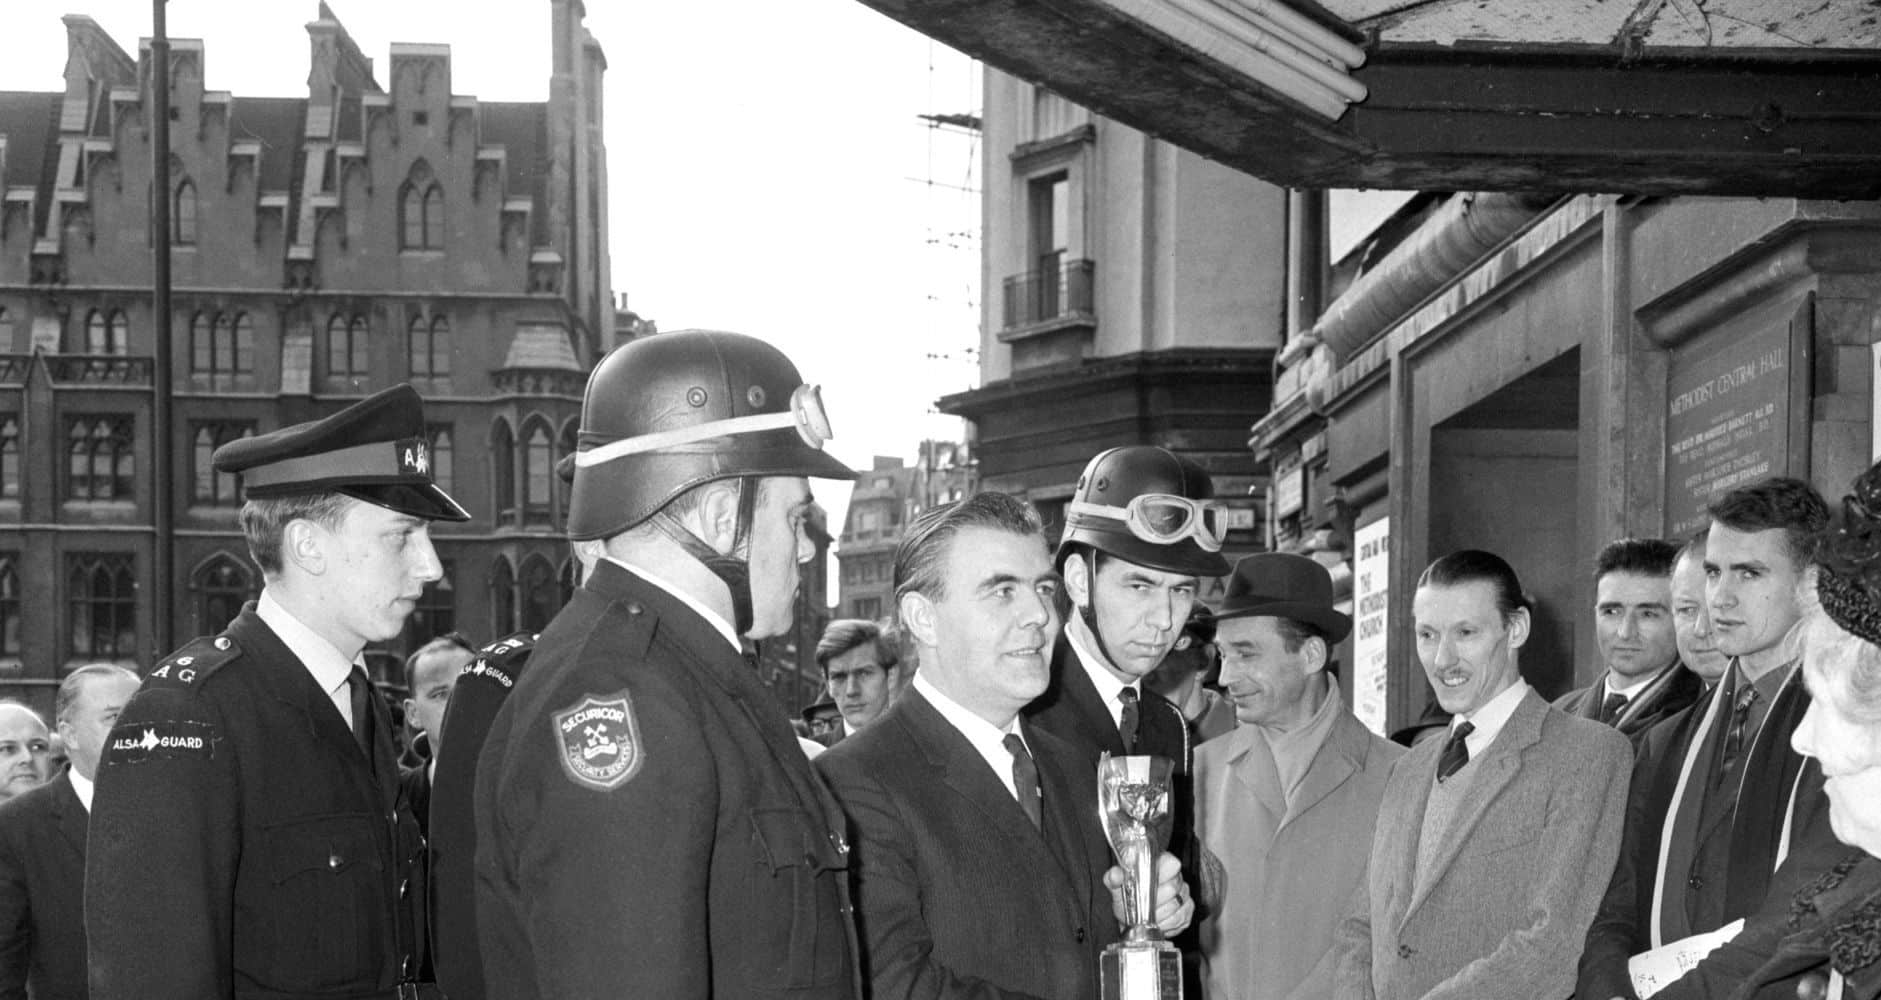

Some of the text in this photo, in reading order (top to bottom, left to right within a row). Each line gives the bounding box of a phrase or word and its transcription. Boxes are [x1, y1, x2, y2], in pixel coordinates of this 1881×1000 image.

[1670, 379, 1715, 416] METHODIST
[1717, 359, 1756, 394] CENTRAL
[1760, 347, 1784, 375] HALL
[1360, 615, 1383, 640] CHURCH
[176, 656, 194, 666] 6
[151, 665, 196, 684] A G
[485, 666, 513, 687] GUARD
[561, 707, 625, 733] SECURICOR
[112, 736, 203, 750] ALSA GUARD
